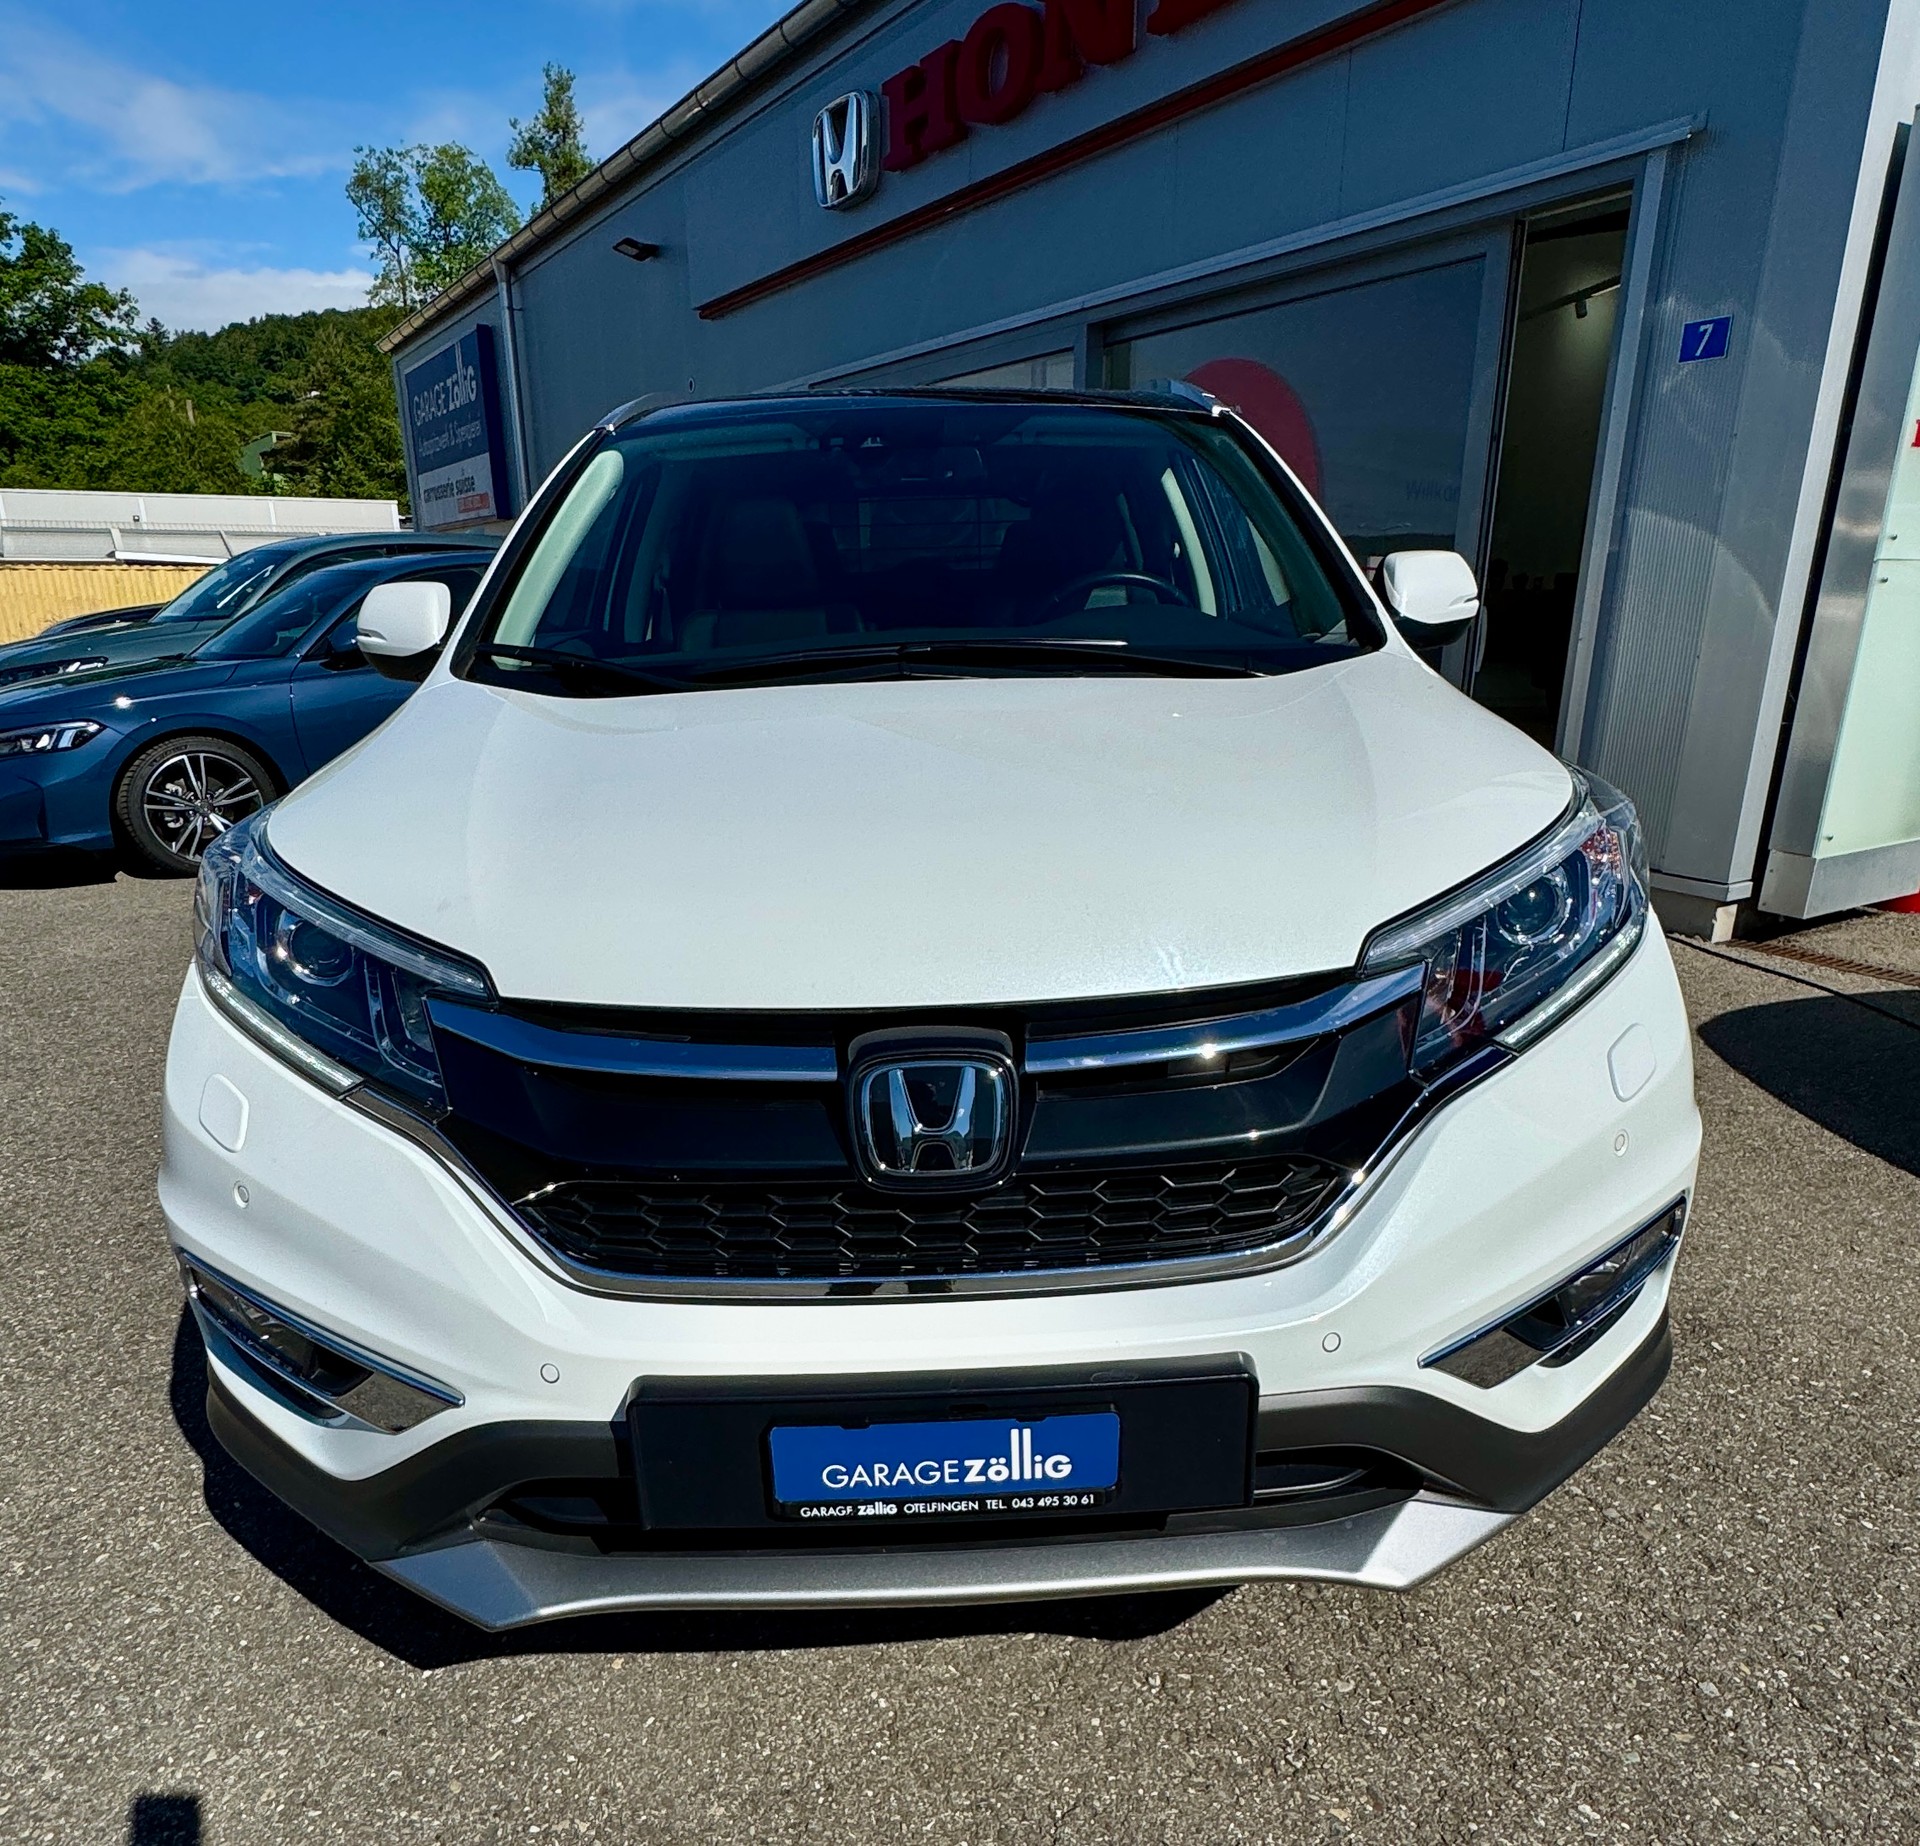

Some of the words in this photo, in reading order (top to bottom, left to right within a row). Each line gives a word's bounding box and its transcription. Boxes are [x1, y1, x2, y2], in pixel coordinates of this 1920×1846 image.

[1695, 323, 1714, 357] 7
[413, 382, 448, 426] GARAGE
[822, 1459, 959, 1488] GARAGE
[903, 1500, 979, 1515] OTELFINGEN
[1011, 1497, 1034, 1509] 043
[1037, 1496, 1060, 1508] 495
[1062, 1495, 1078, 1507] 30
[1080, 1494, 1095, 1506] 61
